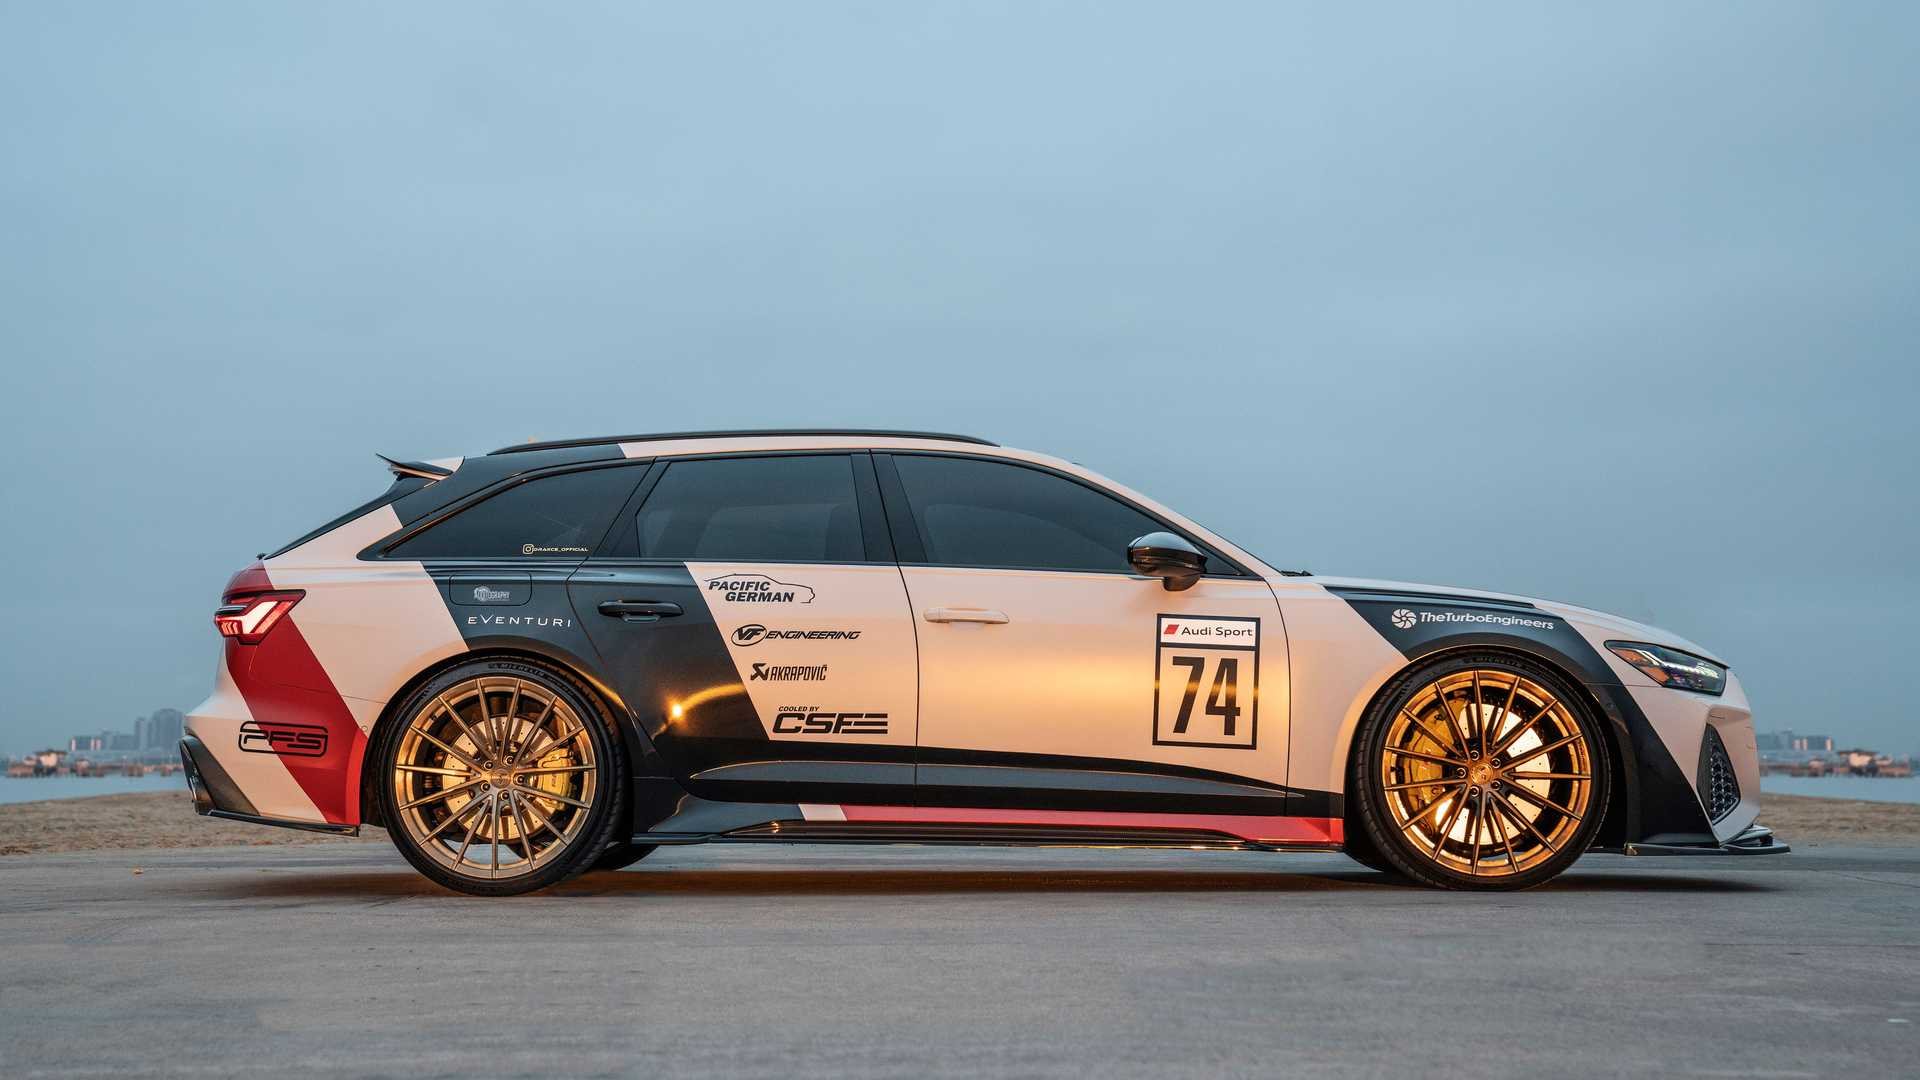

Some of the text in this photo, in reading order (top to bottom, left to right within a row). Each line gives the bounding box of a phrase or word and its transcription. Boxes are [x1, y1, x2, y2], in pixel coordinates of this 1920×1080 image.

[708, 581, 771, 591] PACIFIC
[725, 592, 794, 602] GERMAN
[467, 614, 571, 628] EVENTURI
[1419, 612, 1554, 630] TheTurboEngineers
[736, 627, 861, 641] VF ENGINEERING
[1181, 627, 1253, 638] Audi Sport
[1172, 656, 1241, 736] 74
[240, 727, 328, 752] PFS
